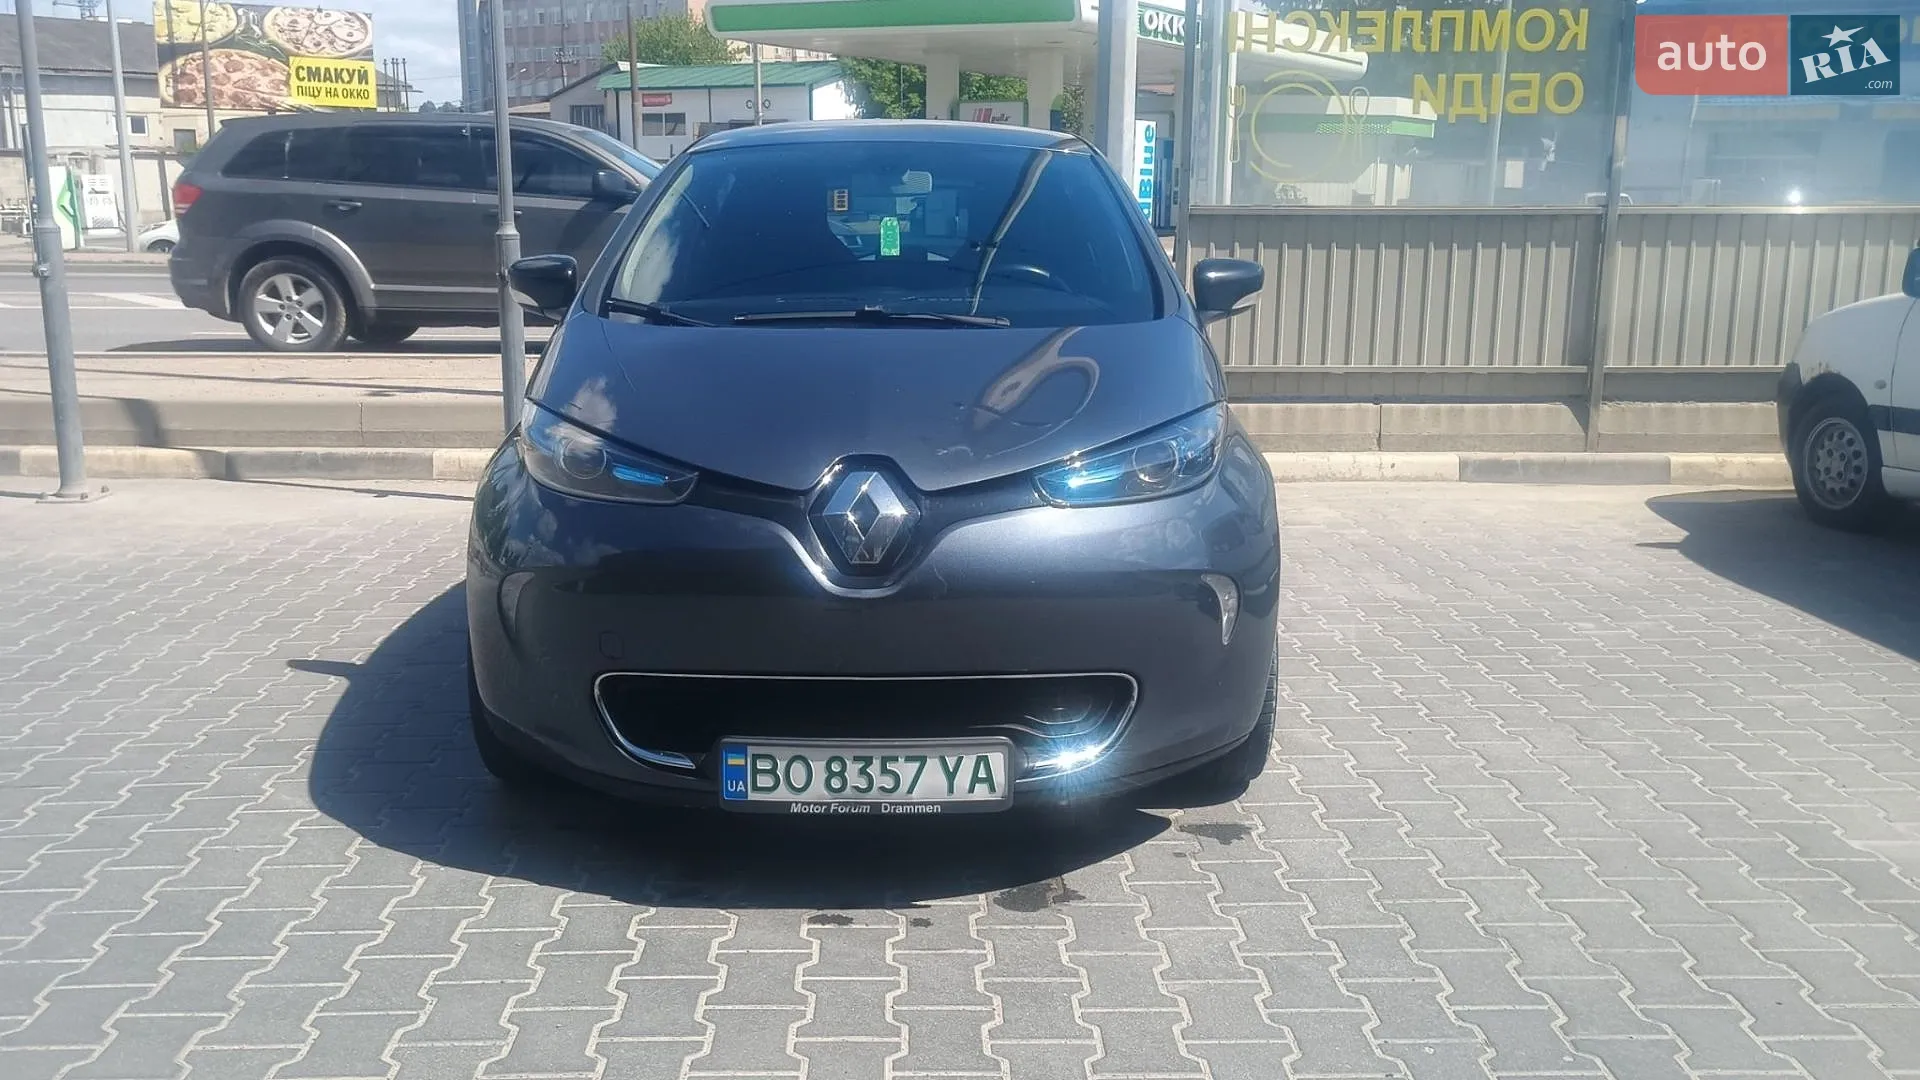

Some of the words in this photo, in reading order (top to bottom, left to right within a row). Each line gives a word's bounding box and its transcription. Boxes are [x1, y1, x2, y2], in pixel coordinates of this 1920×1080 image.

[1144, 9, 1185, 36] OKK
[295, 65, 369, 85] СМАКУЙ
[296, 85, 322, 99] ПІЦУ
[325, 87, 339, 98] НА
[341, 87, 370, 100] ОККО
[751, 753, 814, 795] BO
[823, 754, 928, 795] 8357
[938, 754, 997, 796] YA
[727, 780, 746, 792] UA
[790, 803, 827, 813] Motor
[830, 803, 870, 813] Forum
[881, 803, 941, 813] Drammen
